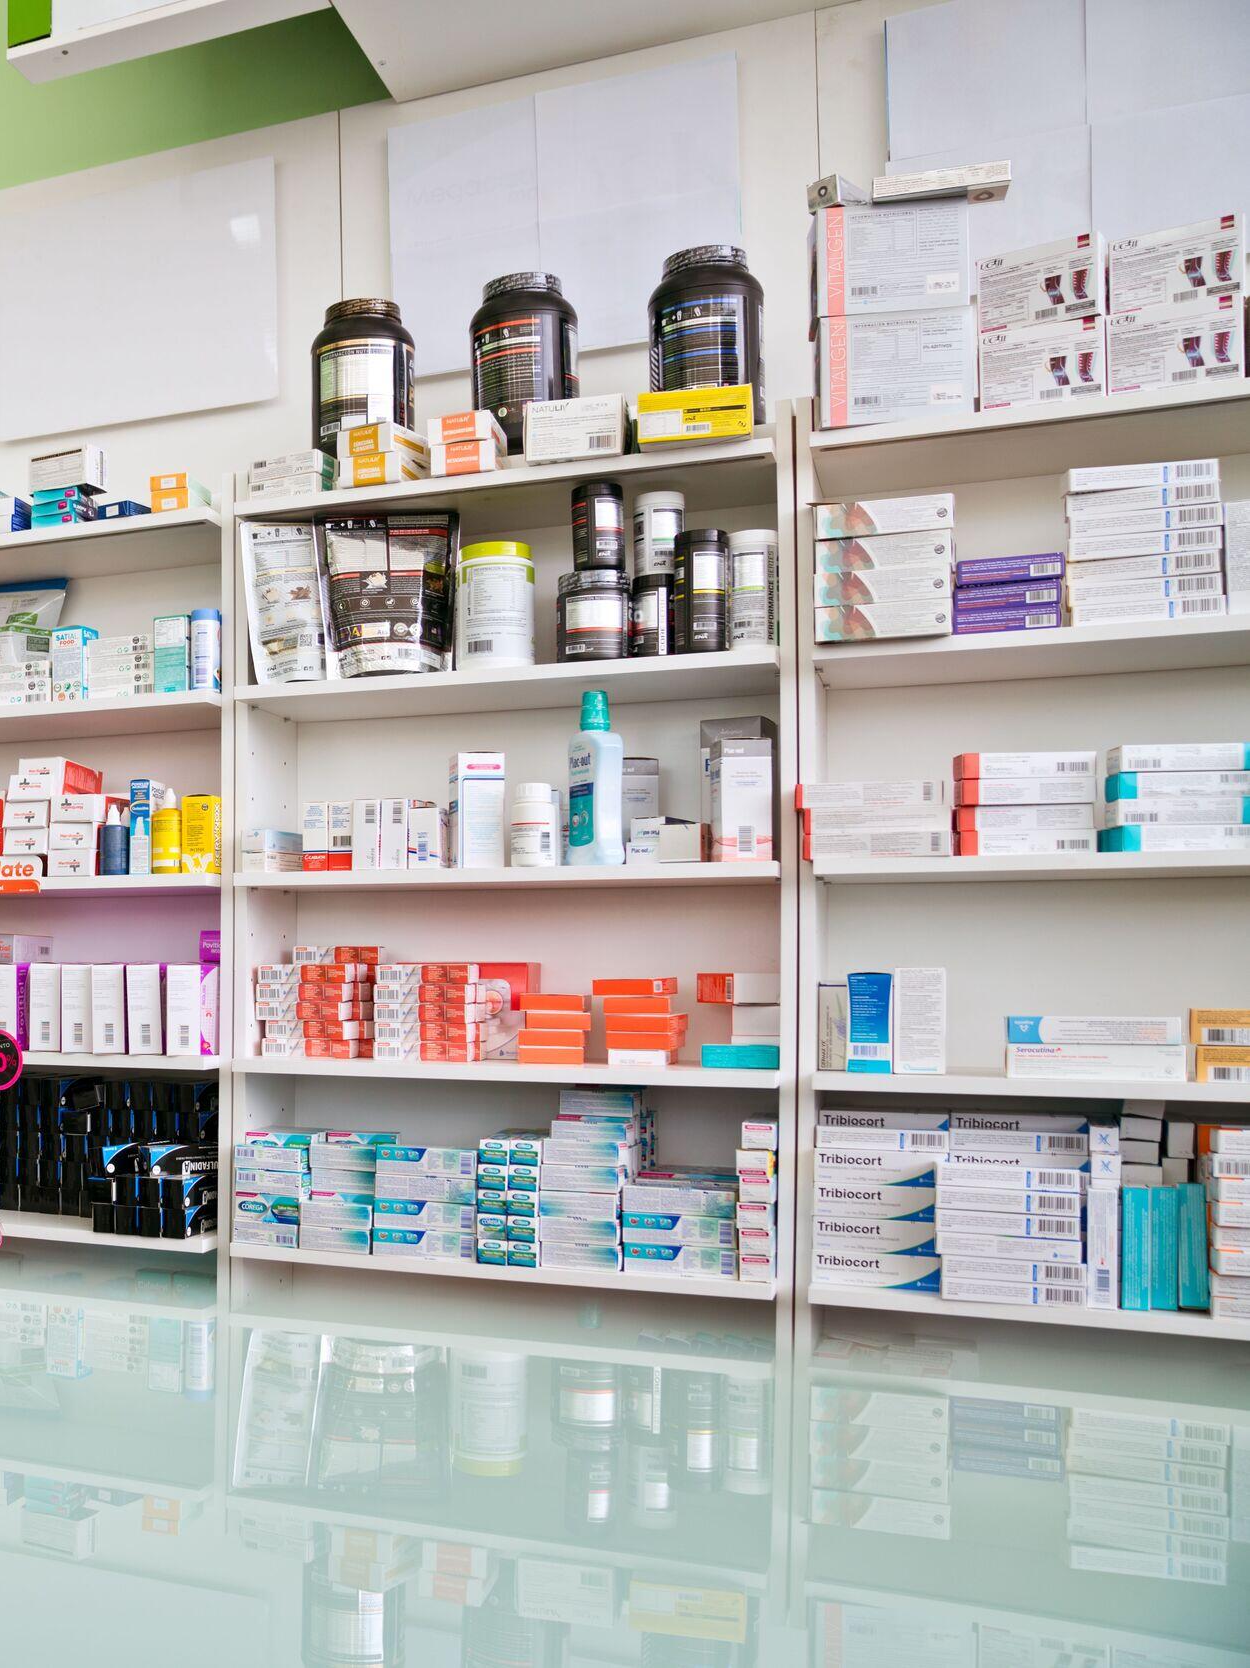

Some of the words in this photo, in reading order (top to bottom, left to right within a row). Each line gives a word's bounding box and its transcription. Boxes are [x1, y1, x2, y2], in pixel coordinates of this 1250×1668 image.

[827, 215, 843, 298] VITALGEN
[830, 324, 846, 408] VITALGEN
[569, 752, 591, 769] Plac-out
[824, 1114, 885, 1127] Tribiocort
[956, 1117, 1020, 1130] Tribiocort
[819, 1153, 882, 1166] Tribiocort
[818, 1187, 882, 1200] Tribiocort
[241, 1202, 264, 1211] COREGA
[817, 1221, 881, 1235] Tribiocort
[817, 1254, 880, 1269] Tribiocort
